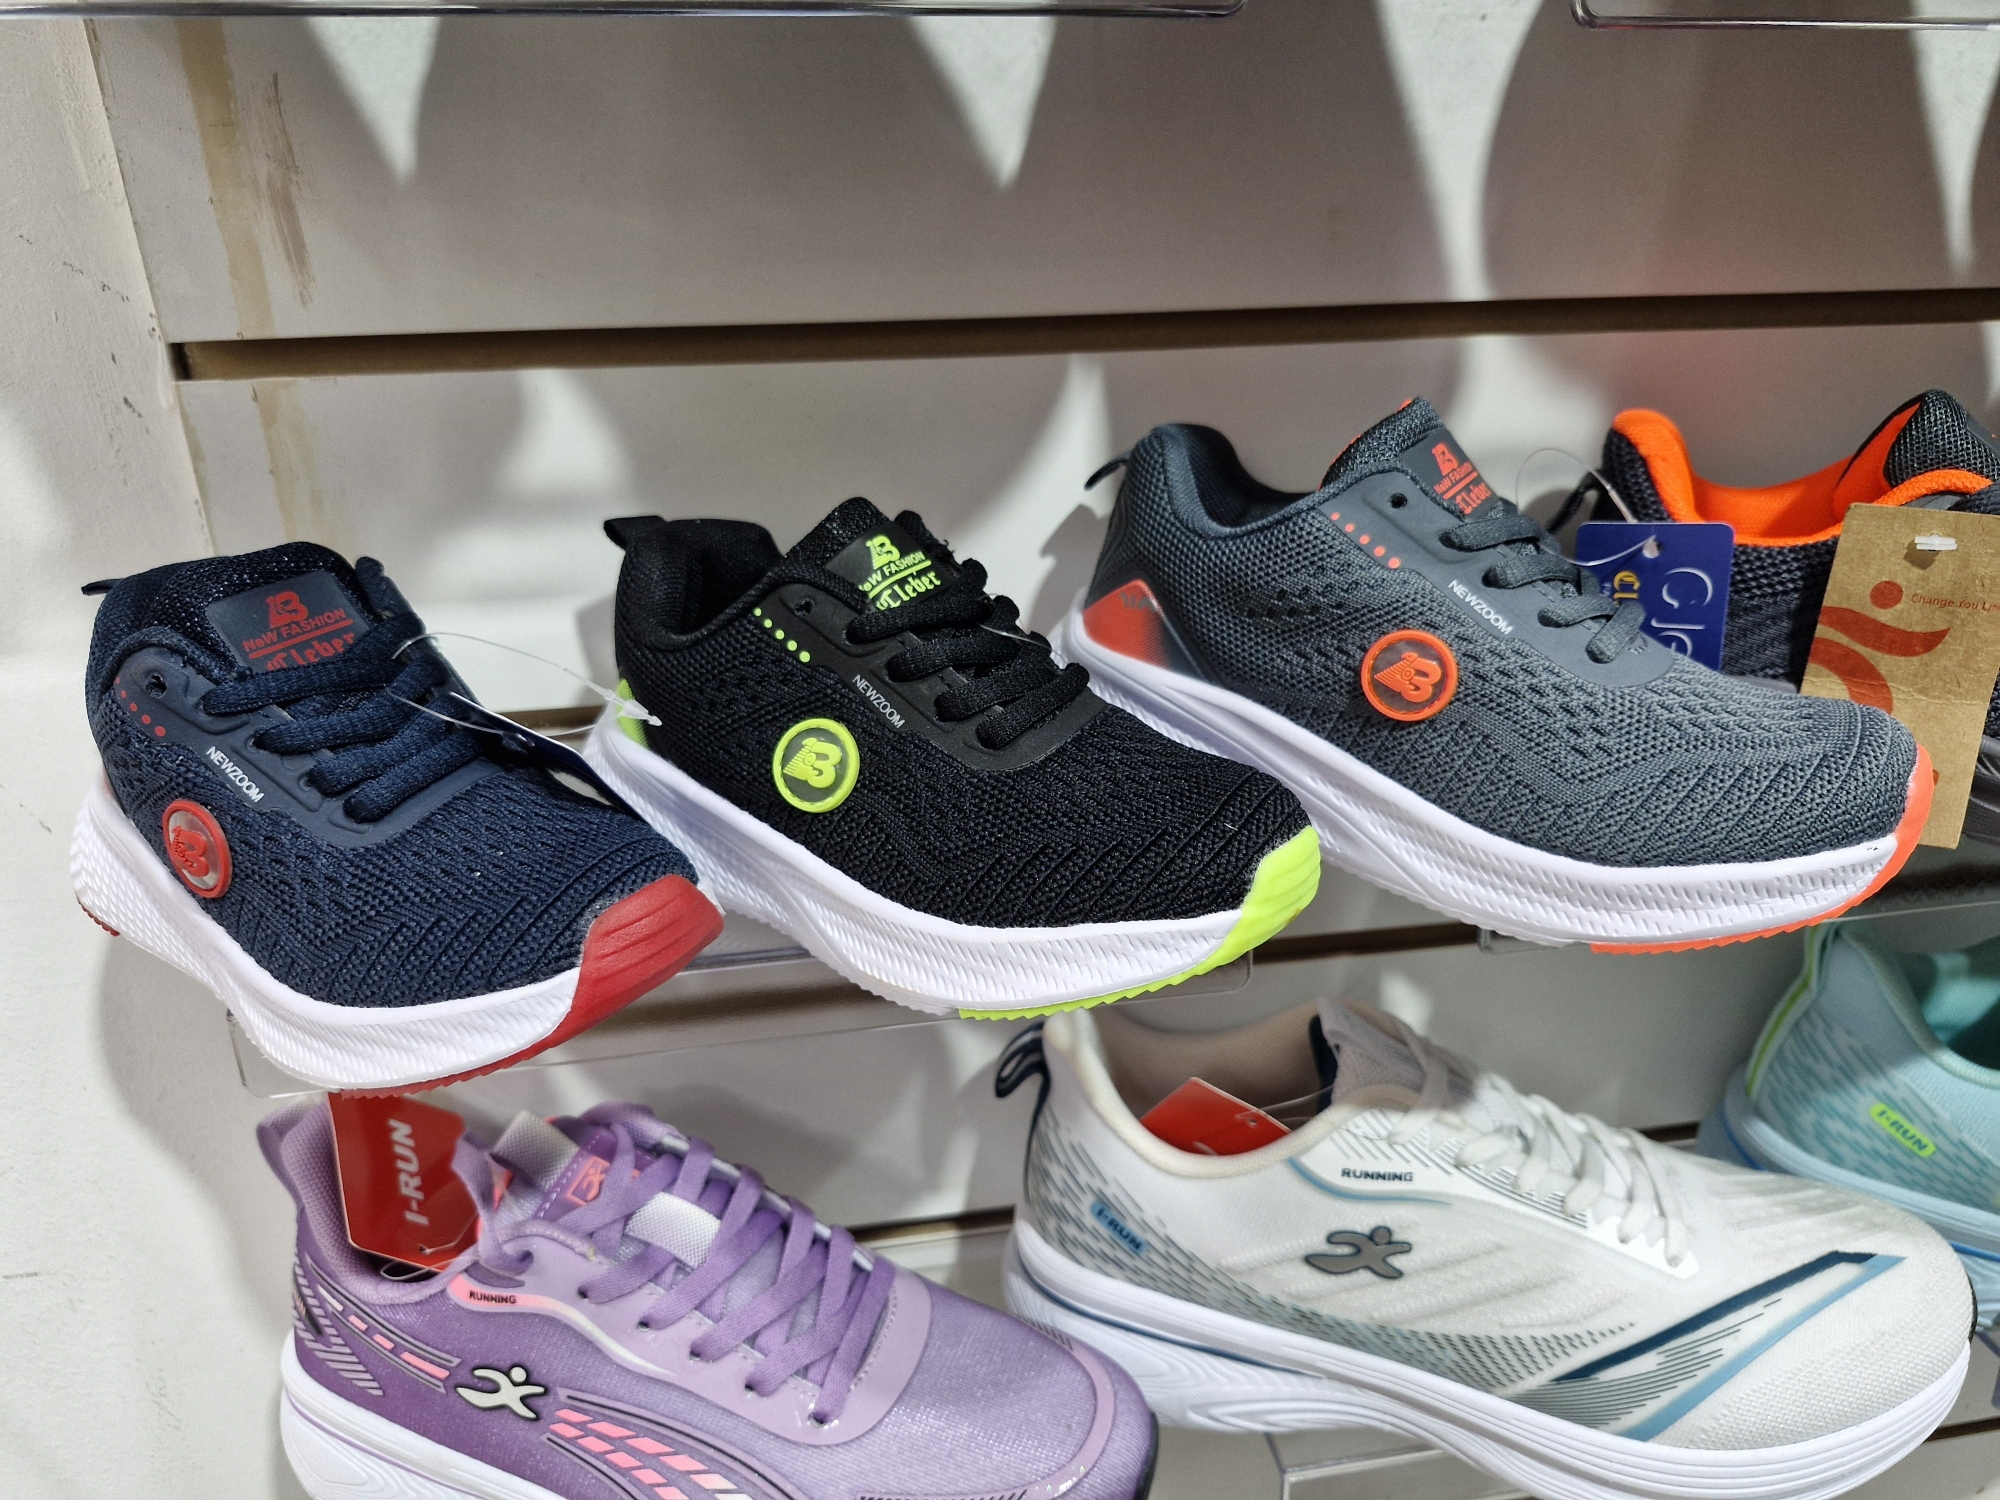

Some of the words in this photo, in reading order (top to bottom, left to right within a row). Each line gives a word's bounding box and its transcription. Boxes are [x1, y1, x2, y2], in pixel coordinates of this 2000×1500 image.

[883, 550, 926, 576] FASHION
[1447, 579, 1514, 635] NEWZOOM
[1911, 593, 1955, 609] Change
[1958, 598, 1979, 610] You
[281, 608, 347, 639] FASHION
[852, 674, 906, 729] NEWZOOM
[206, 746, 265, 803] NEWZOOM
[1878, 1110, 1929, 1151] I-RUN
[387, 1118, 430, 1227] I-RUN
[1340, 1167, 1414, 1182] RUNNING
[1096, 1207, 1143, 1250] I-RUN
[469, 1290, 517, 1305] RUNNING
